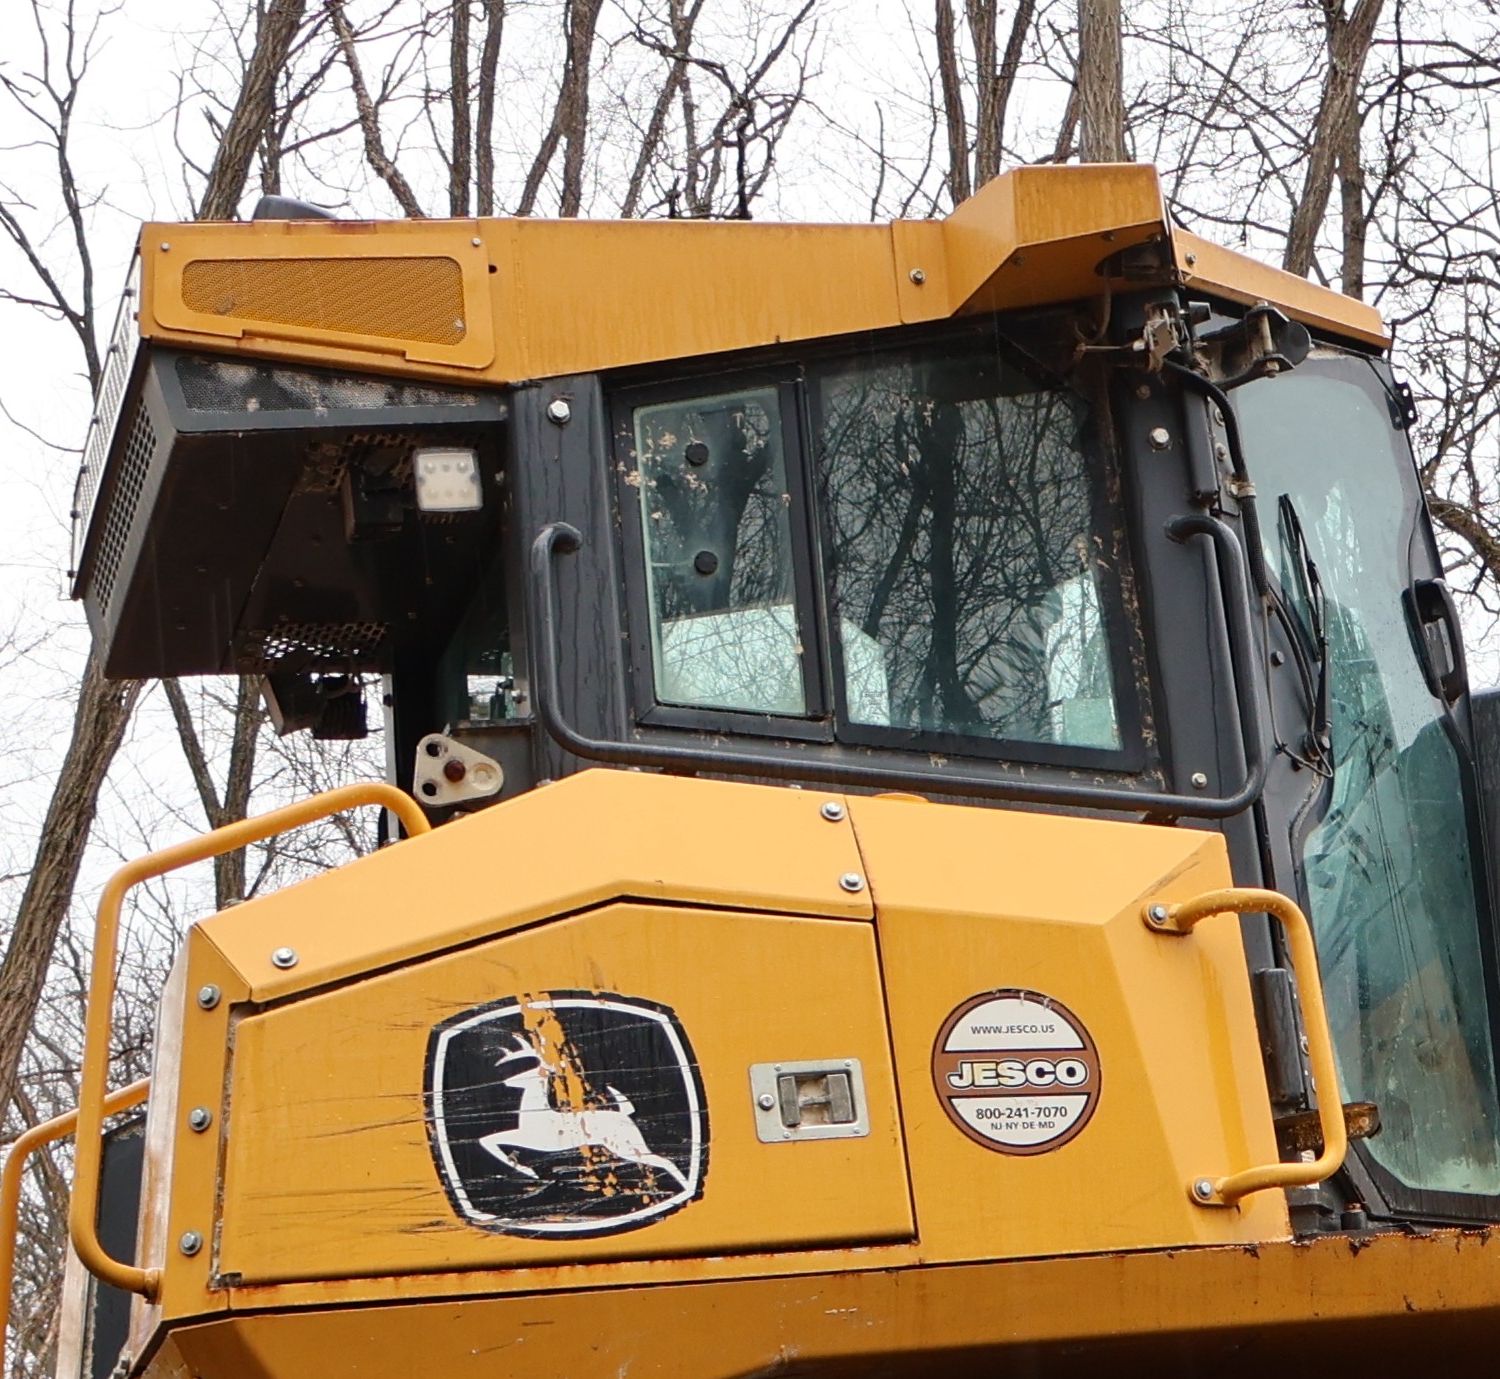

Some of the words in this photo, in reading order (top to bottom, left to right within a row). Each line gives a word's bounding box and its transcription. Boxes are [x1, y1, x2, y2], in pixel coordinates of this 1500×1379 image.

[970, 1024, 1055, 1035] WWW.JESCO.US
[947, 1058, 1088, 1088] JESCO
[976, 1107, 1067, 1119] 800-241-7070
